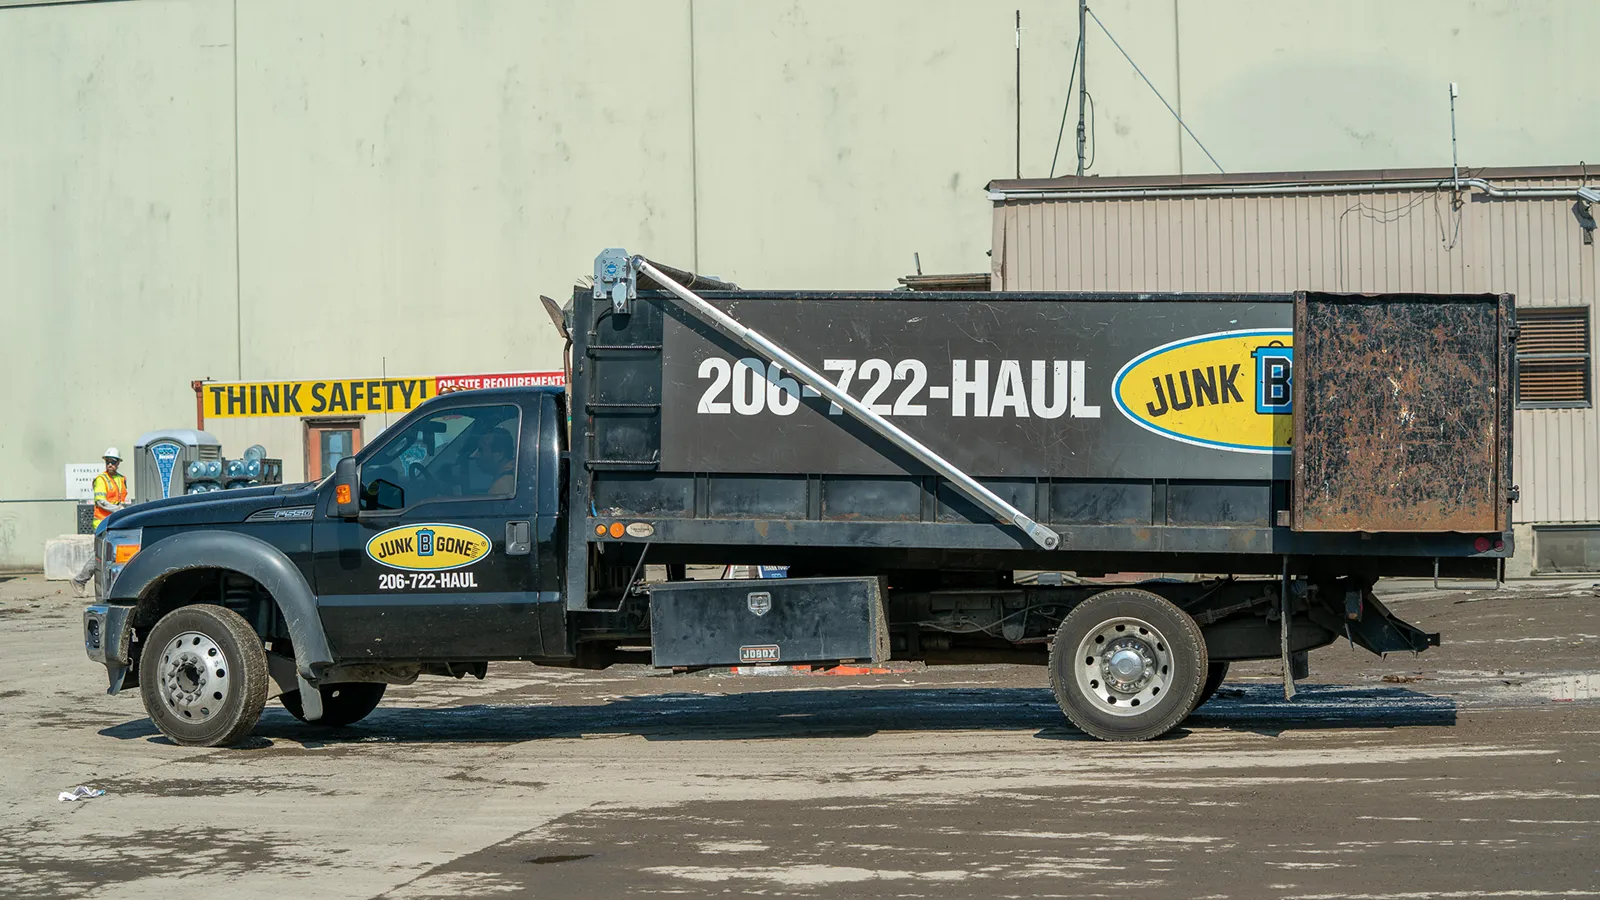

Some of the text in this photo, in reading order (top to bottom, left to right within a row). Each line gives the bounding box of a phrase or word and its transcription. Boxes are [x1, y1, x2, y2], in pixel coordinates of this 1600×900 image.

[209, 380, 427, 415] THINK SAFETY!
[697, 358, 1101, 419] 206-722-HAUL
[1146, 356, 1292, 417] JUNK B
[378, 537, 414, 558] JUNK
[420, 534, 432, 553] B
[436, 536, 473, 557] GONE
[379, 572, 478, 589] 206-722-HAUL
[743, 649, 776, 659] JOBOX
